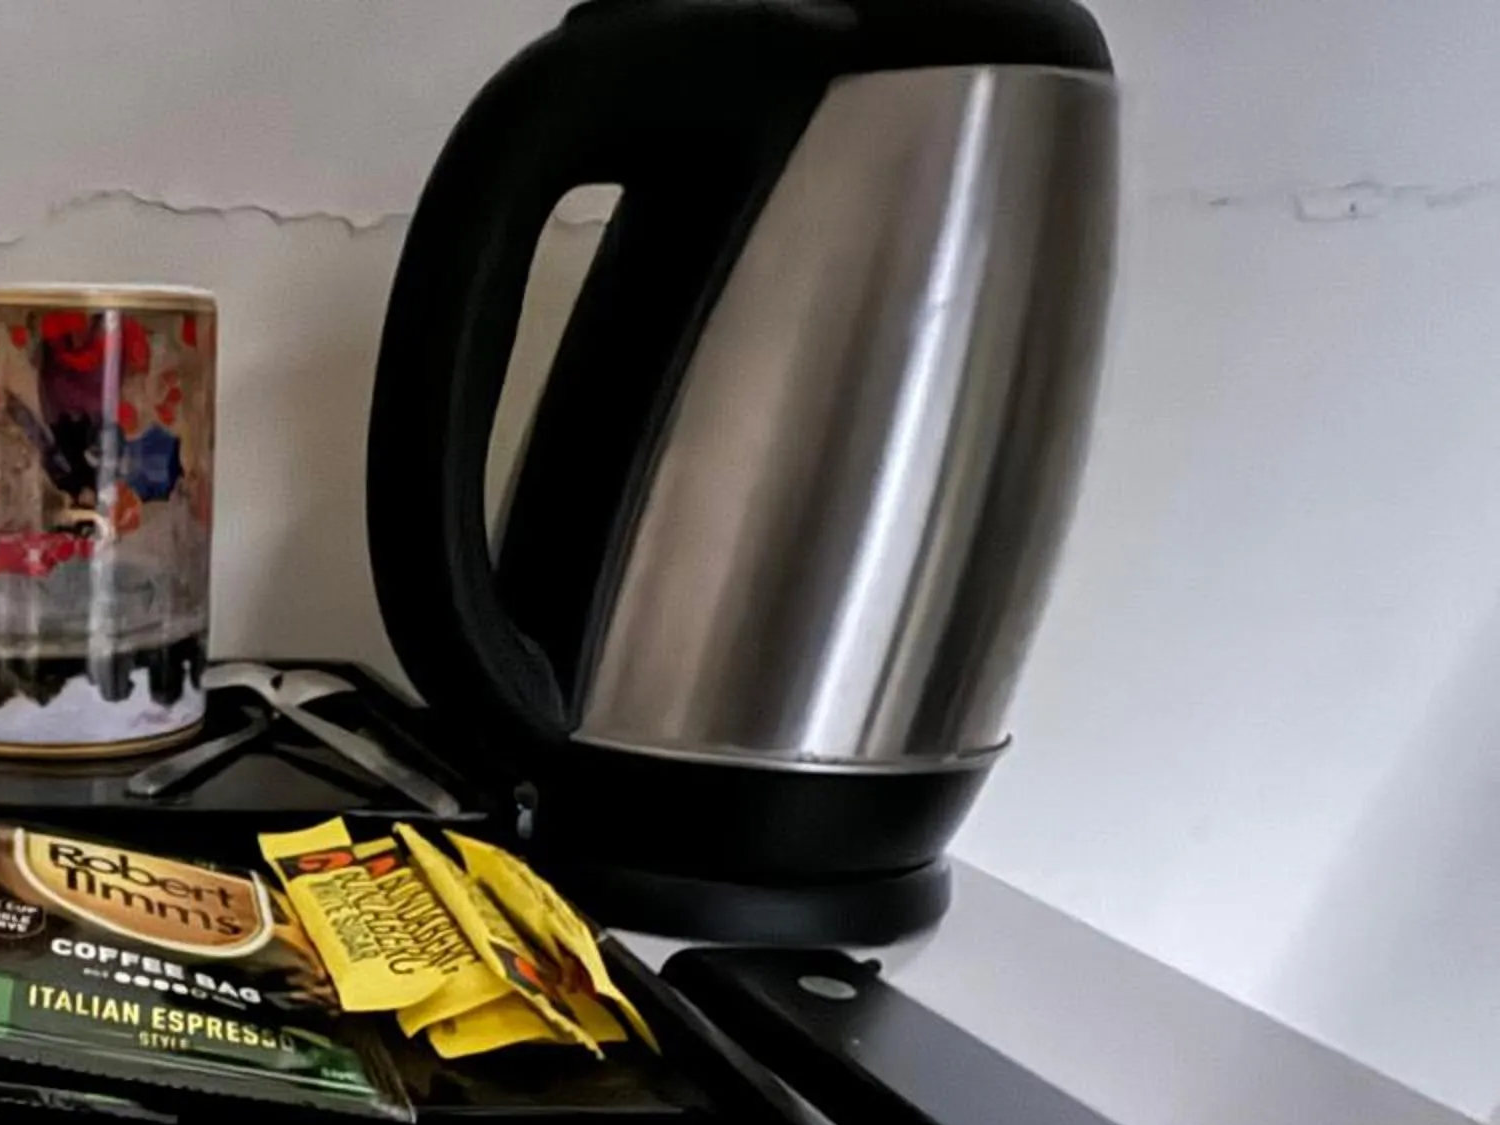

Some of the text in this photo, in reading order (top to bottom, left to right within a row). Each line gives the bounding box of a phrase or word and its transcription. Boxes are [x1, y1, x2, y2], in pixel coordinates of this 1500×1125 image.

[49, 843, 235, 909] Robert
[63, 867, 242, 936] Timms
[51, 938, 186, 980] COFFEE
[195, 972, 262, 1004] BAG
[28, 984, 141, 1026] ITALIAN
[139, 1030, 191, 1050] STYLE
